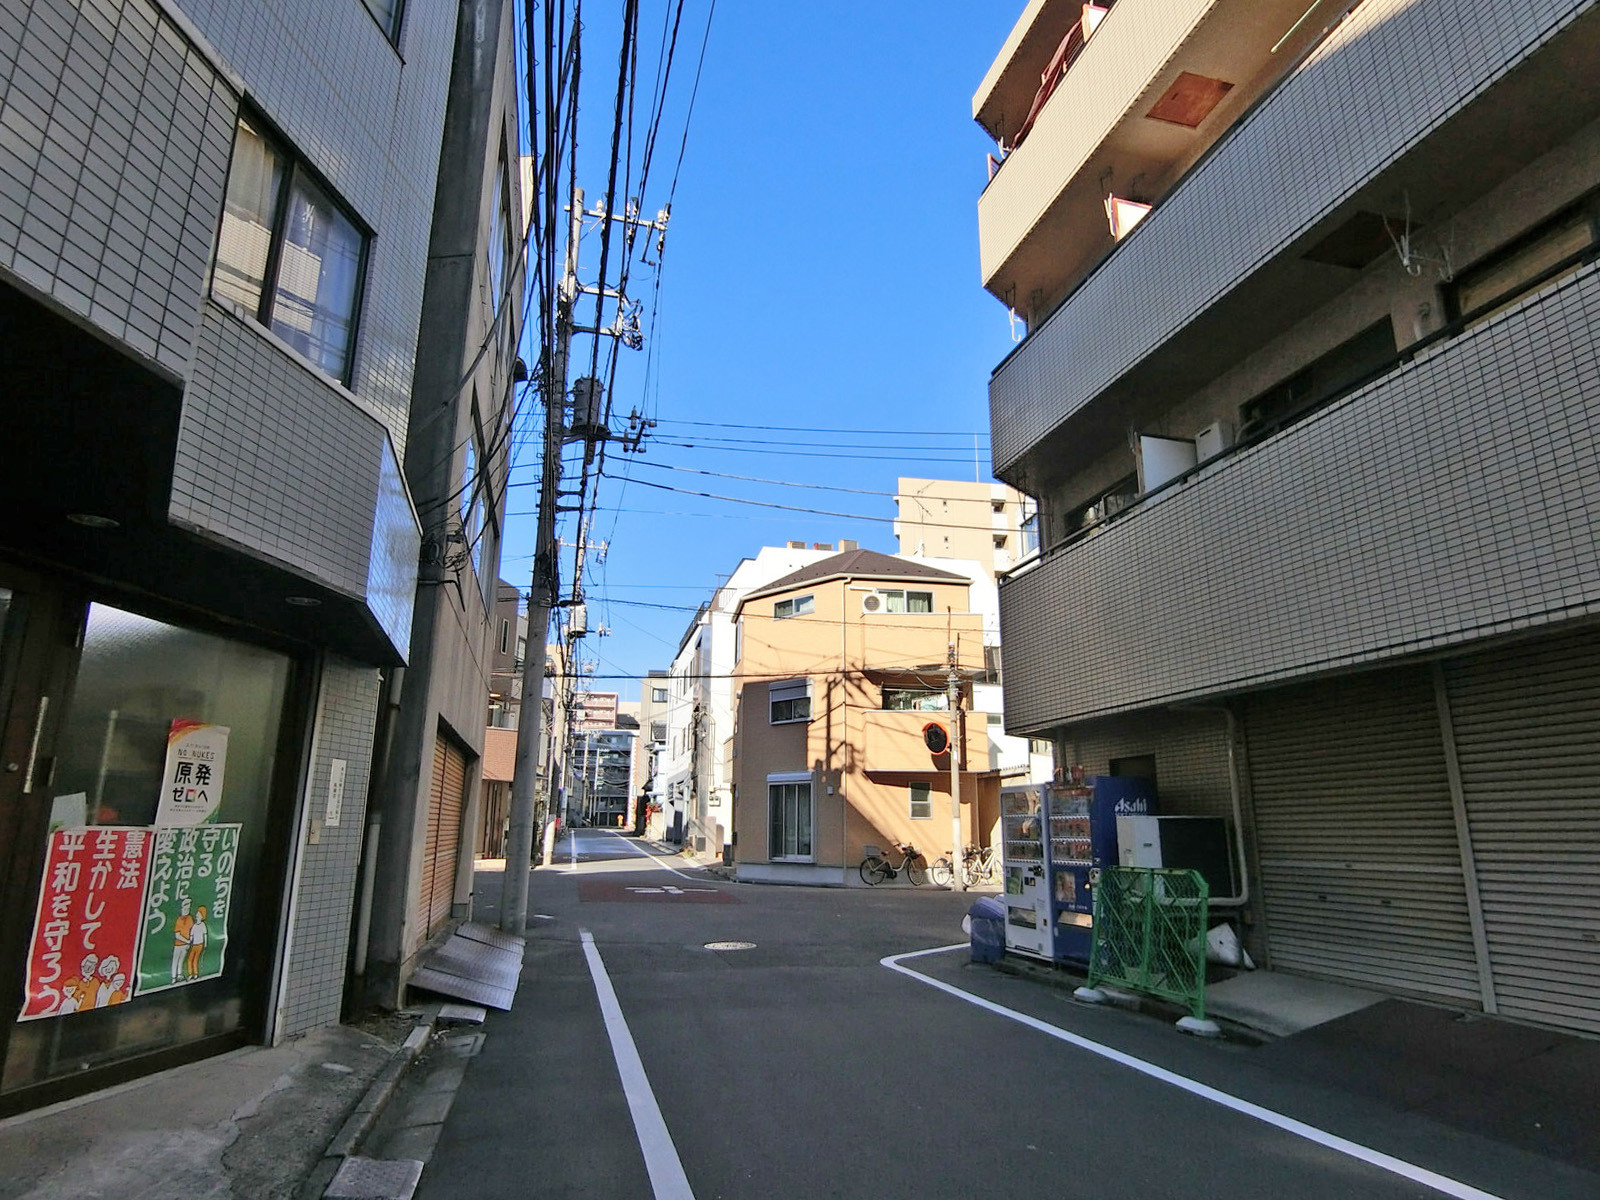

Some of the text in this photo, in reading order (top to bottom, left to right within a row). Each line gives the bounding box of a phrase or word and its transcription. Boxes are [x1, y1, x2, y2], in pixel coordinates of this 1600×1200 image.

[174, 761, 212, 786] 原発
[192, 750, 215, 760] NUKES
[172, 786, 209, 803] ゼロへ
[1114, 798, 1147, 812] Asahi
[116, 830, 146, 890] 憲法
[148, 827, 179, 935] 変えよう
[174, 828, 200, 901] 政治に
[197, 827, 221, 878] 守る
[213, 828, 238, 919] いのちを
[80, 830, 119, 950] 生かして
[37, 830, 88, 1015] 平和を守ろう
